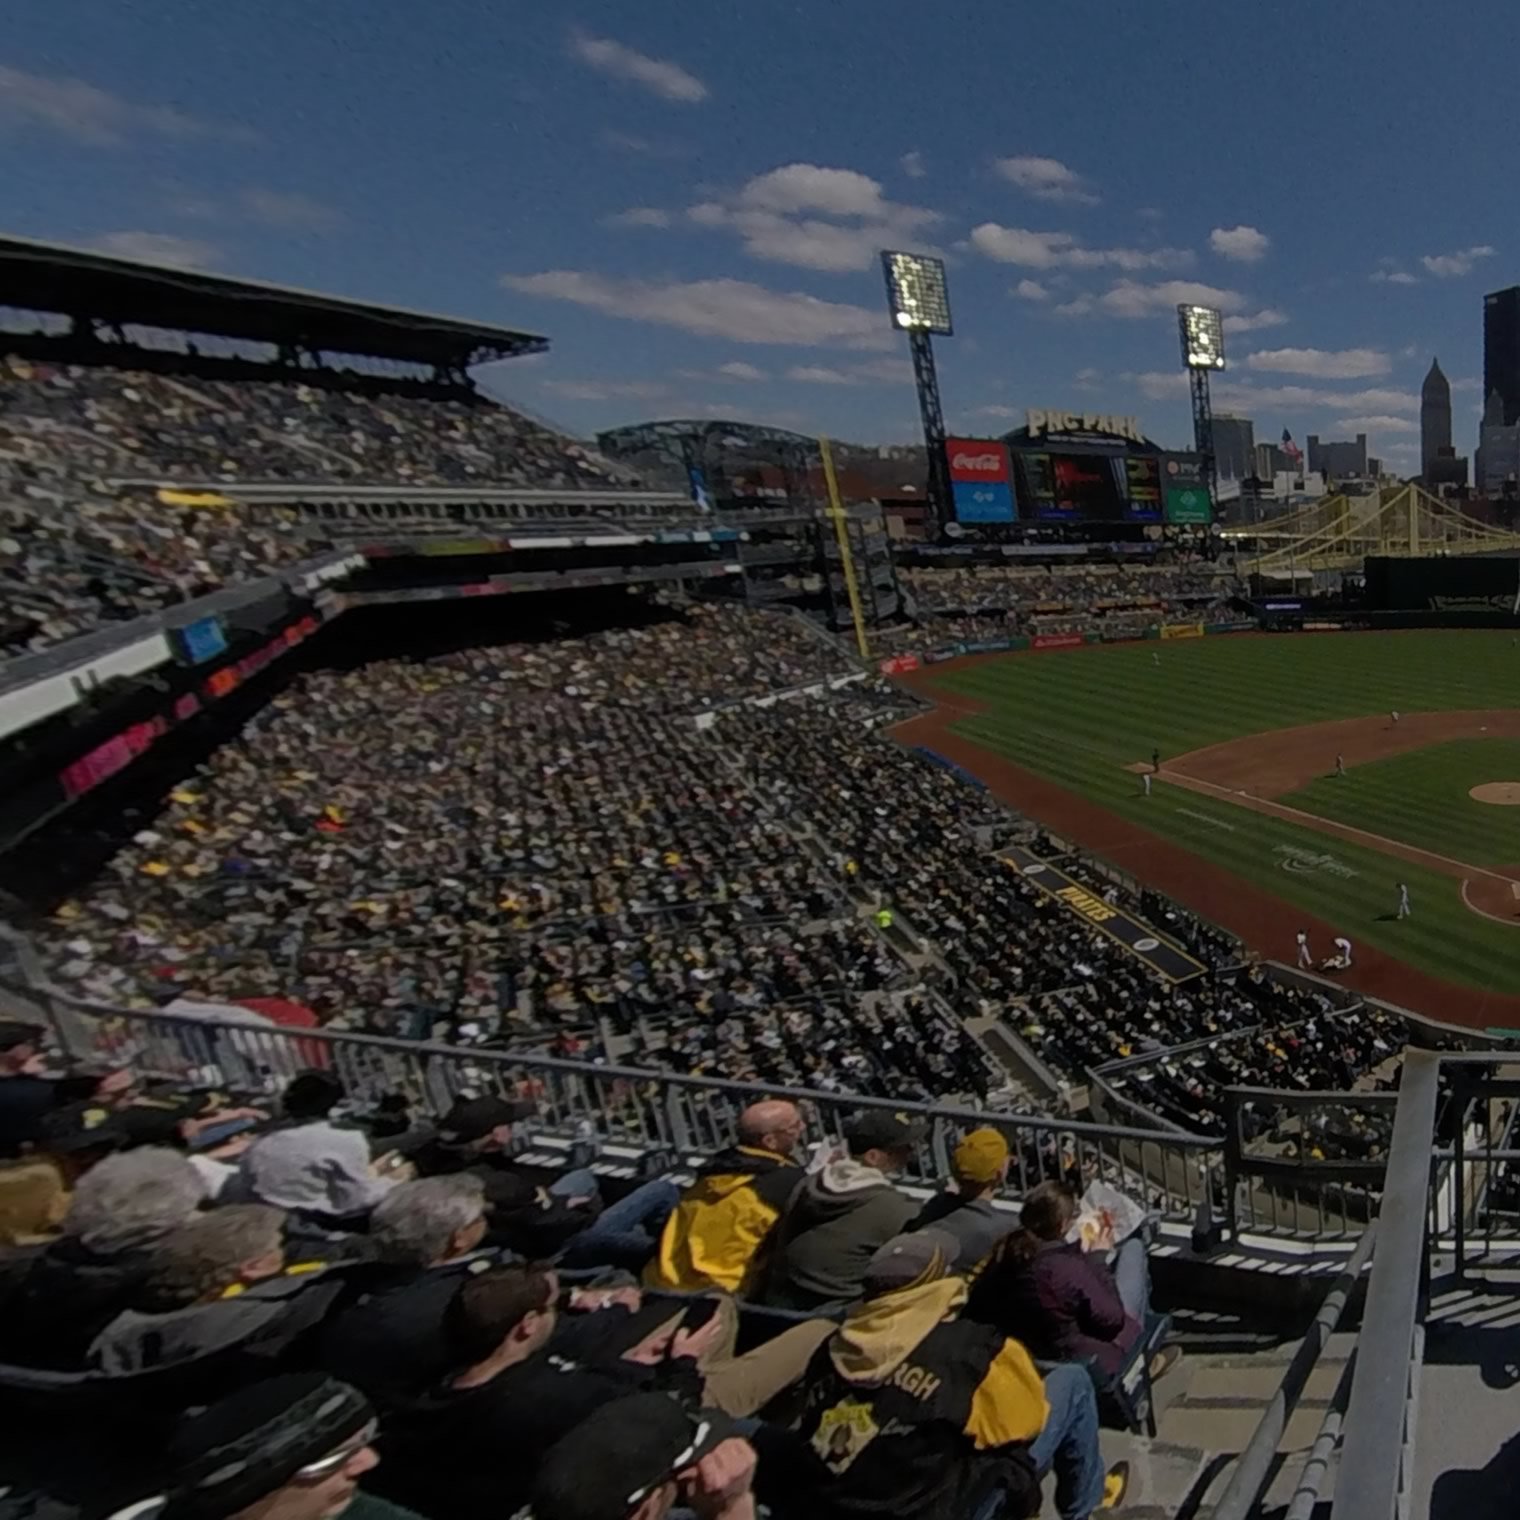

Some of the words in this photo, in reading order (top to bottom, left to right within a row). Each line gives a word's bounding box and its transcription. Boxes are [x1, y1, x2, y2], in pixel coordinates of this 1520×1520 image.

[1025, 408, 1080, 439] PNC
[1082, 414, 1146, 445] PARK
[1055, 885, 1117, 922] PIRATES
